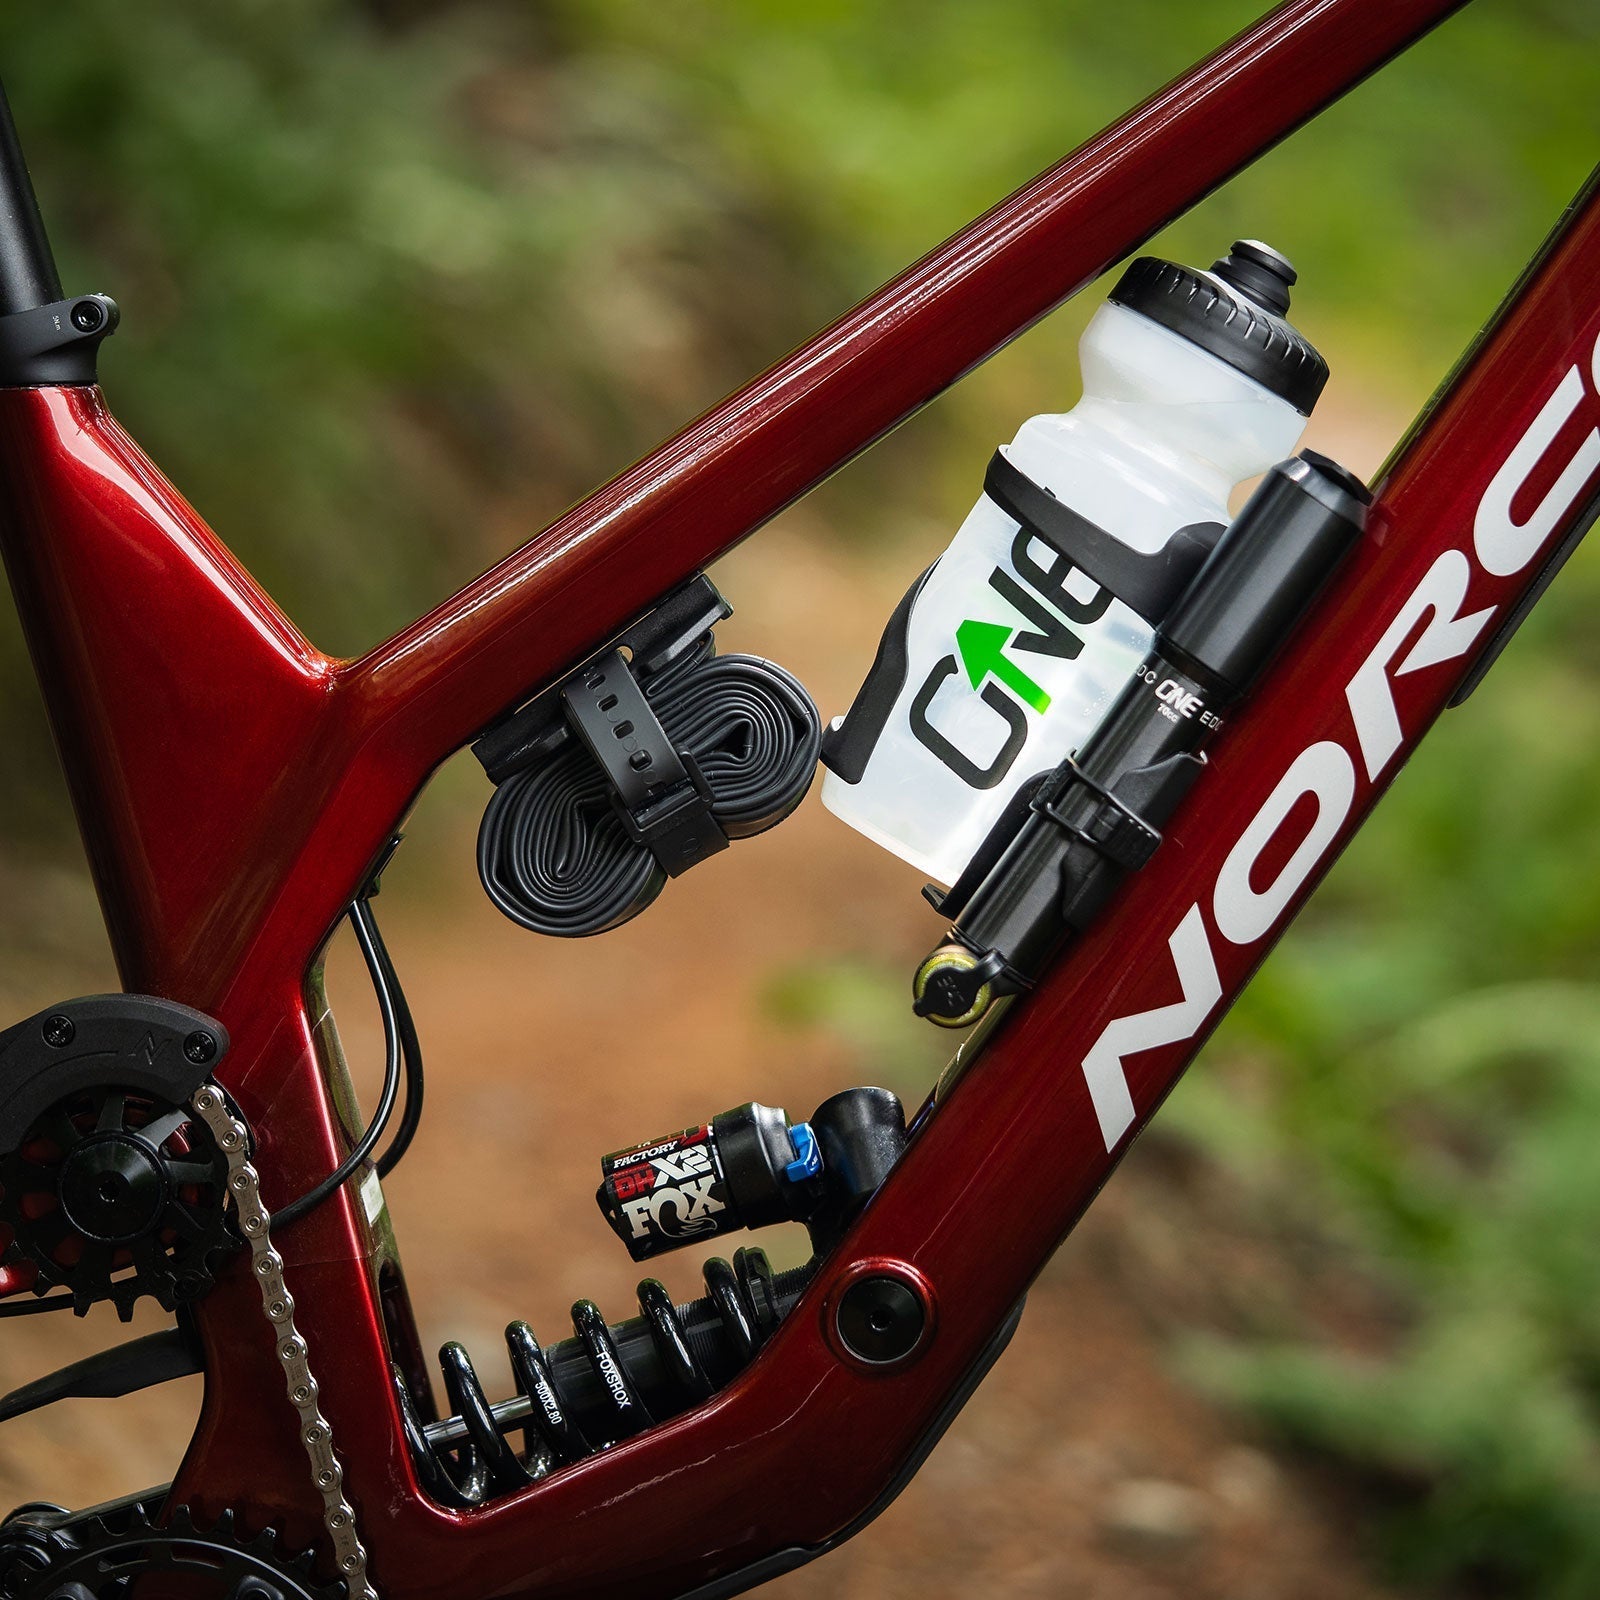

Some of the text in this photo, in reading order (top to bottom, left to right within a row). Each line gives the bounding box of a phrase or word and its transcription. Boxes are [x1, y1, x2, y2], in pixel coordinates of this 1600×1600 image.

[1154, 679, 1205, 719] ONE
[1081, 331, 1600, 1154] NORC
[613, 1140, 678, 1169] FACTORY
[621, 1174, 726, 1239] FOX
[596, 1351, 632, 1409] FOXSHOX
